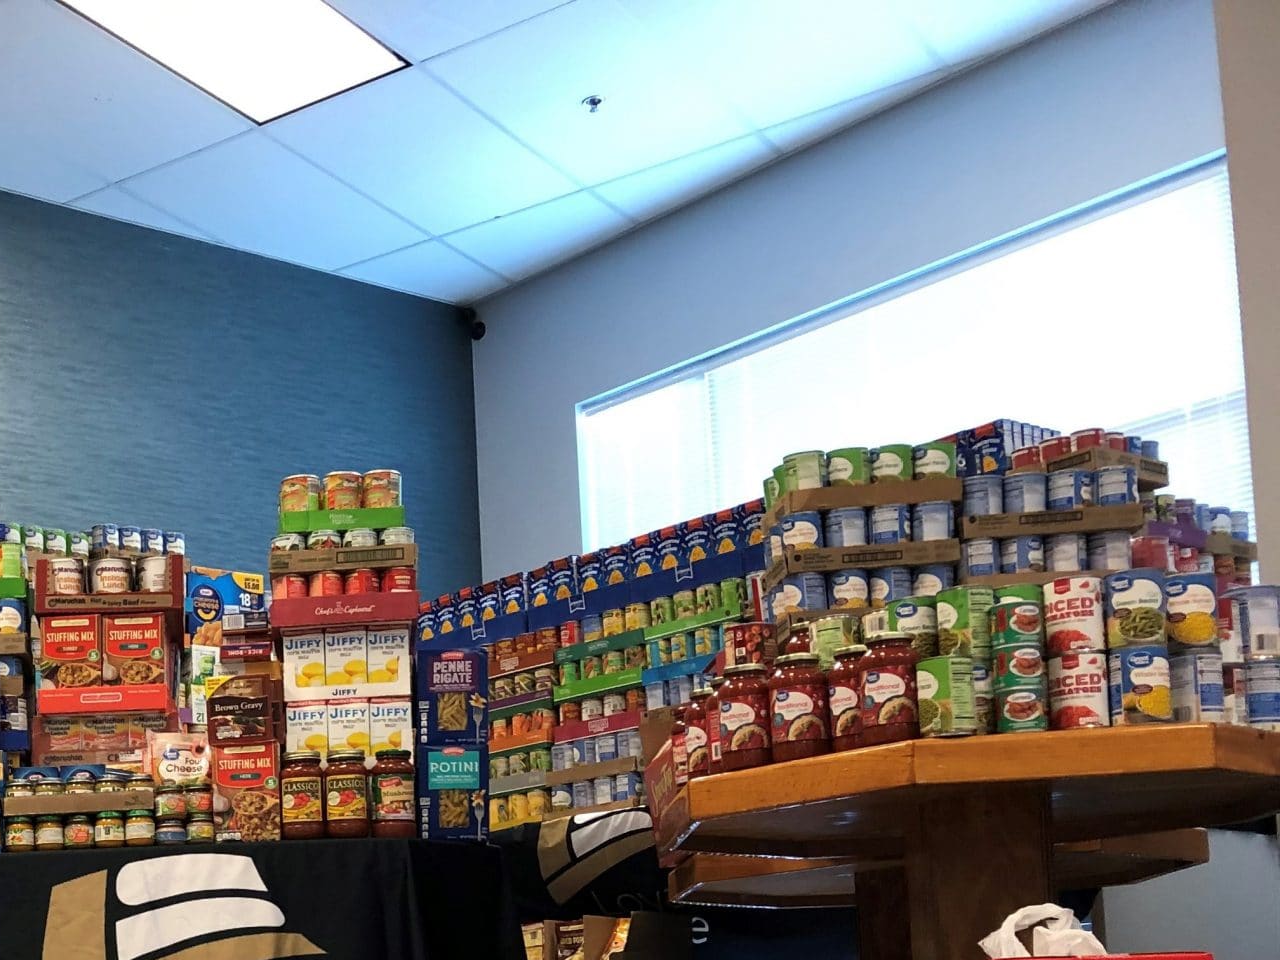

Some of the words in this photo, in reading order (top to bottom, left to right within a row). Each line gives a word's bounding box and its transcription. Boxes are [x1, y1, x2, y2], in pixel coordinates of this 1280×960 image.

[957, 454, 967, 467] 6
[239, 592, 251, 607] 18
[46, 631, 80, 643] STUFFING
[80, 631, 95, 641] MIX
[108, 629, 143, 641] STUFFING
[144, 628, 159, 639] MIX
[368, 633, 407, 645] JIFFY
[285, 639, 322, 651] JIFFY
[326, 636, 364, 647] JIFFY
[432, 660, 473, 674] PENNE
[432, 672, 473, 684] RIGATE
[331, 688, 358, 696] JIFFY
[214, 703, 239, 713] Brown
[240, 701, 264, 713] Gravy
[329, 707, 367, 719] JIFFY
[371, 706, 409, 718] JIFFY
[287, 710, 325, 722] JIFFY
[166, 763, 203, 774] Cheese
[218, 758, 256, 771] STUFFING
[256, 756, 272, 769] MIX
[430, 761, 480, 774] ROTINI
[283, 782, 321, 792] CLASSICO
[328, 779, 365, 789] CLASSICO
